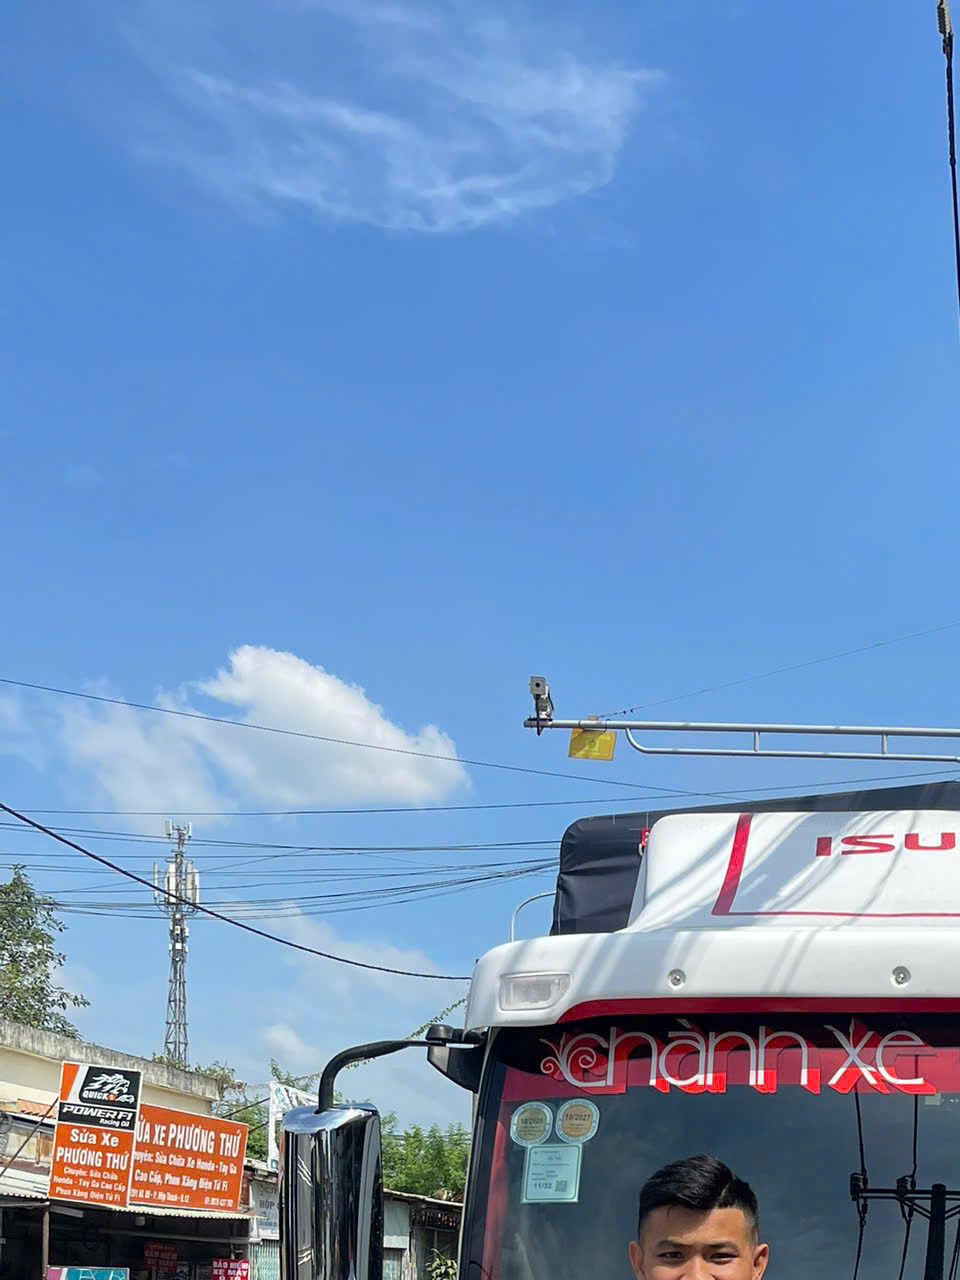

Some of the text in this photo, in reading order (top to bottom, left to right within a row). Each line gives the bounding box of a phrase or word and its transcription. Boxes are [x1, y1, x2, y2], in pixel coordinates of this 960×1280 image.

[82, 1090, 108, 1100] QUICK
[63, 1105, 115, 1120] POWER
[99, 1118, 120, 1127] Racing
[70, 1128, 119, 1147] Sửa Xe
[136, 1114, 242, 1158] ỬA XE PHƯƠNG THỨ
[56, 1147, 129, 1171] PHƯƠNG THỨ
